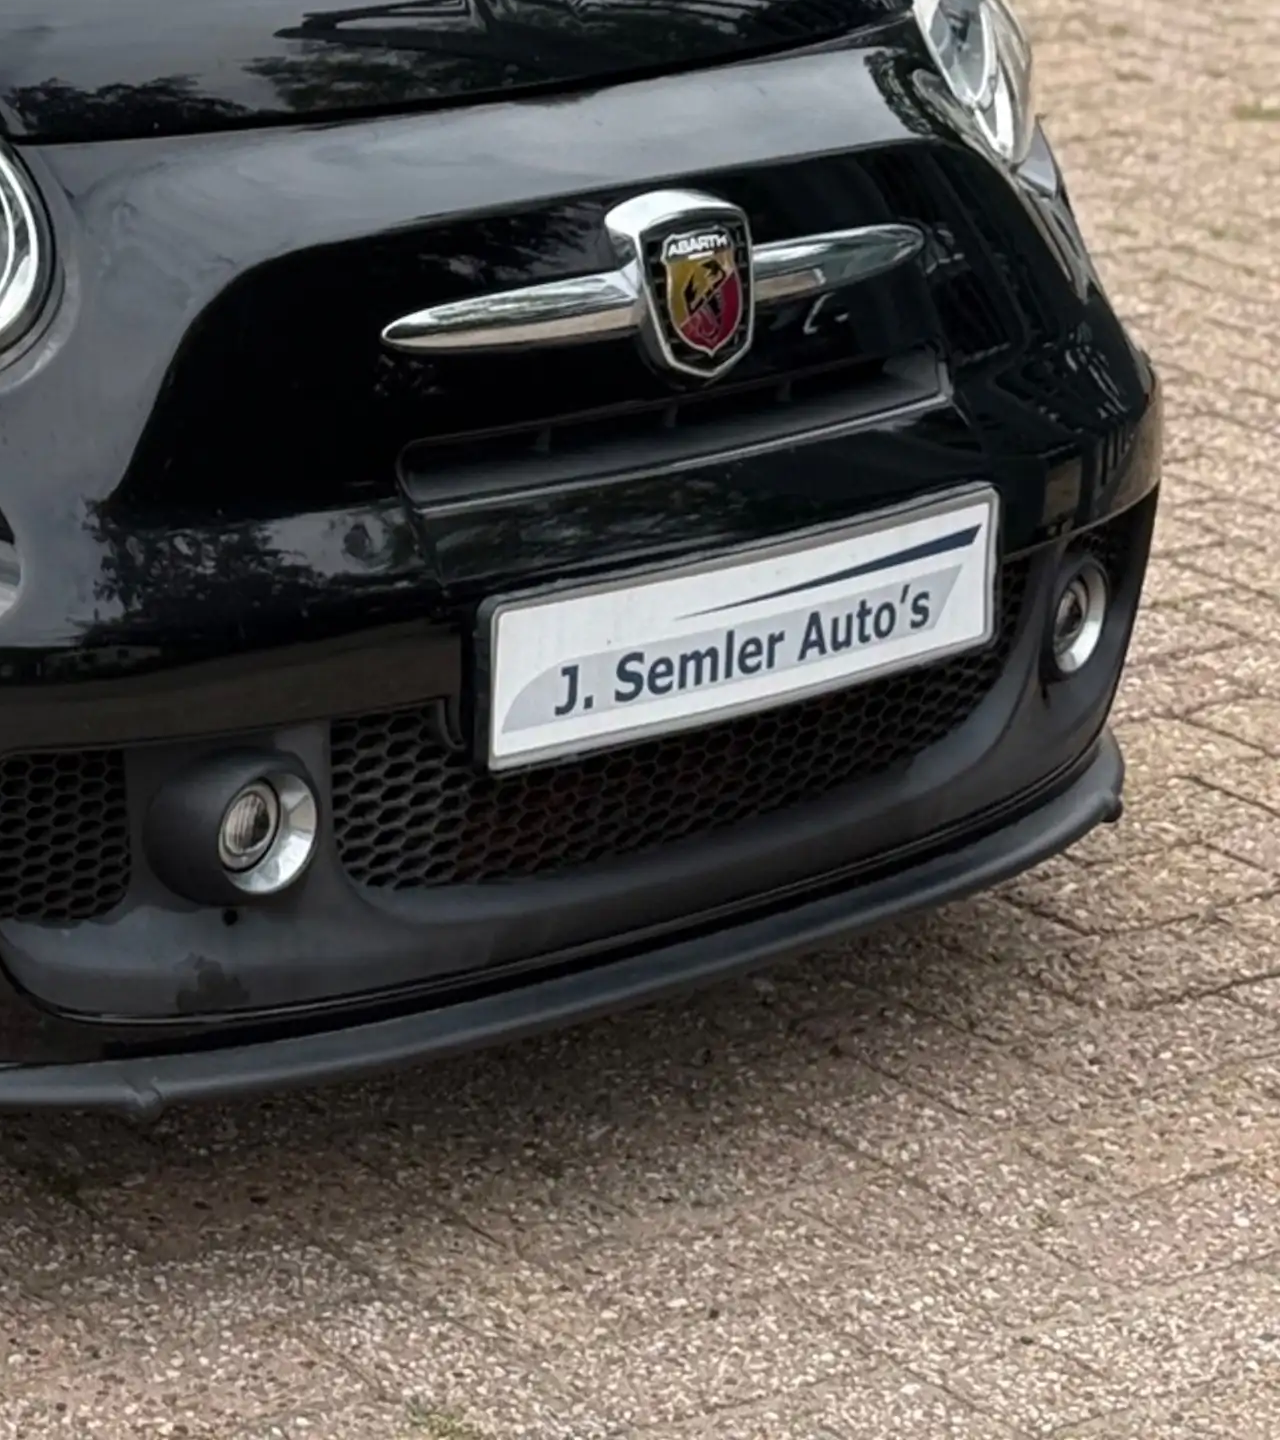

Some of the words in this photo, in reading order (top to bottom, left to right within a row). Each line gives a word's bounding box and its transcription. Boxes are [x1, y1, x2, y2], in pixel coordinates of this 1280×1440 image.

[668, 234, 728, 257] ABARTH
[554, 664, 595, 717] J.
[614, 629, 785, 702] Semler
[798, 584, 931, 660] Auto's
